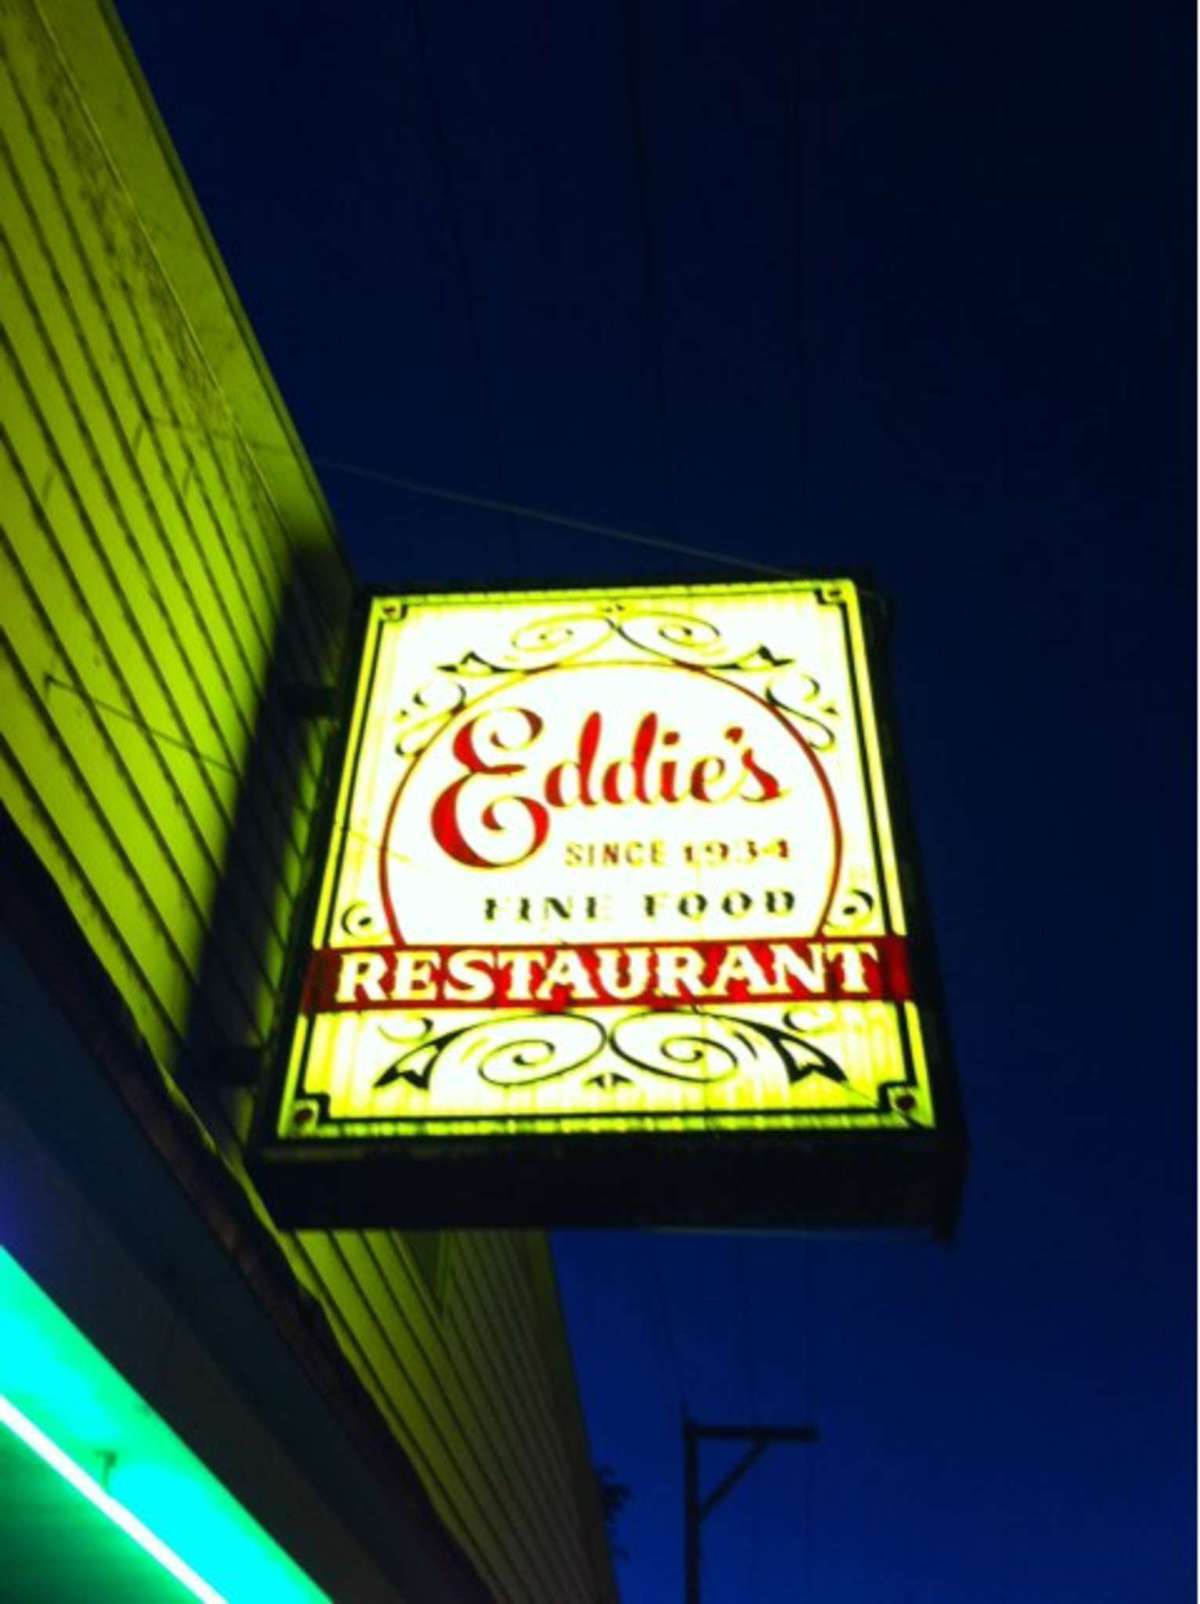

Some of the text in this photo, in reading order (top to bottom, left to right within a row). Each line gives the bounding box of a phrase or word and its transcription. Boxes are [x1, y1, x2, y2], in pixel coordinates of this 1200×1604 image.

[431, 706, 789, 869] Eddie's
[564, 838, 791, 867] SINCE 1934
[484, 891, 796, 921] FINE FOOD
[335, 943, 880, 1003] RESTAURANT
